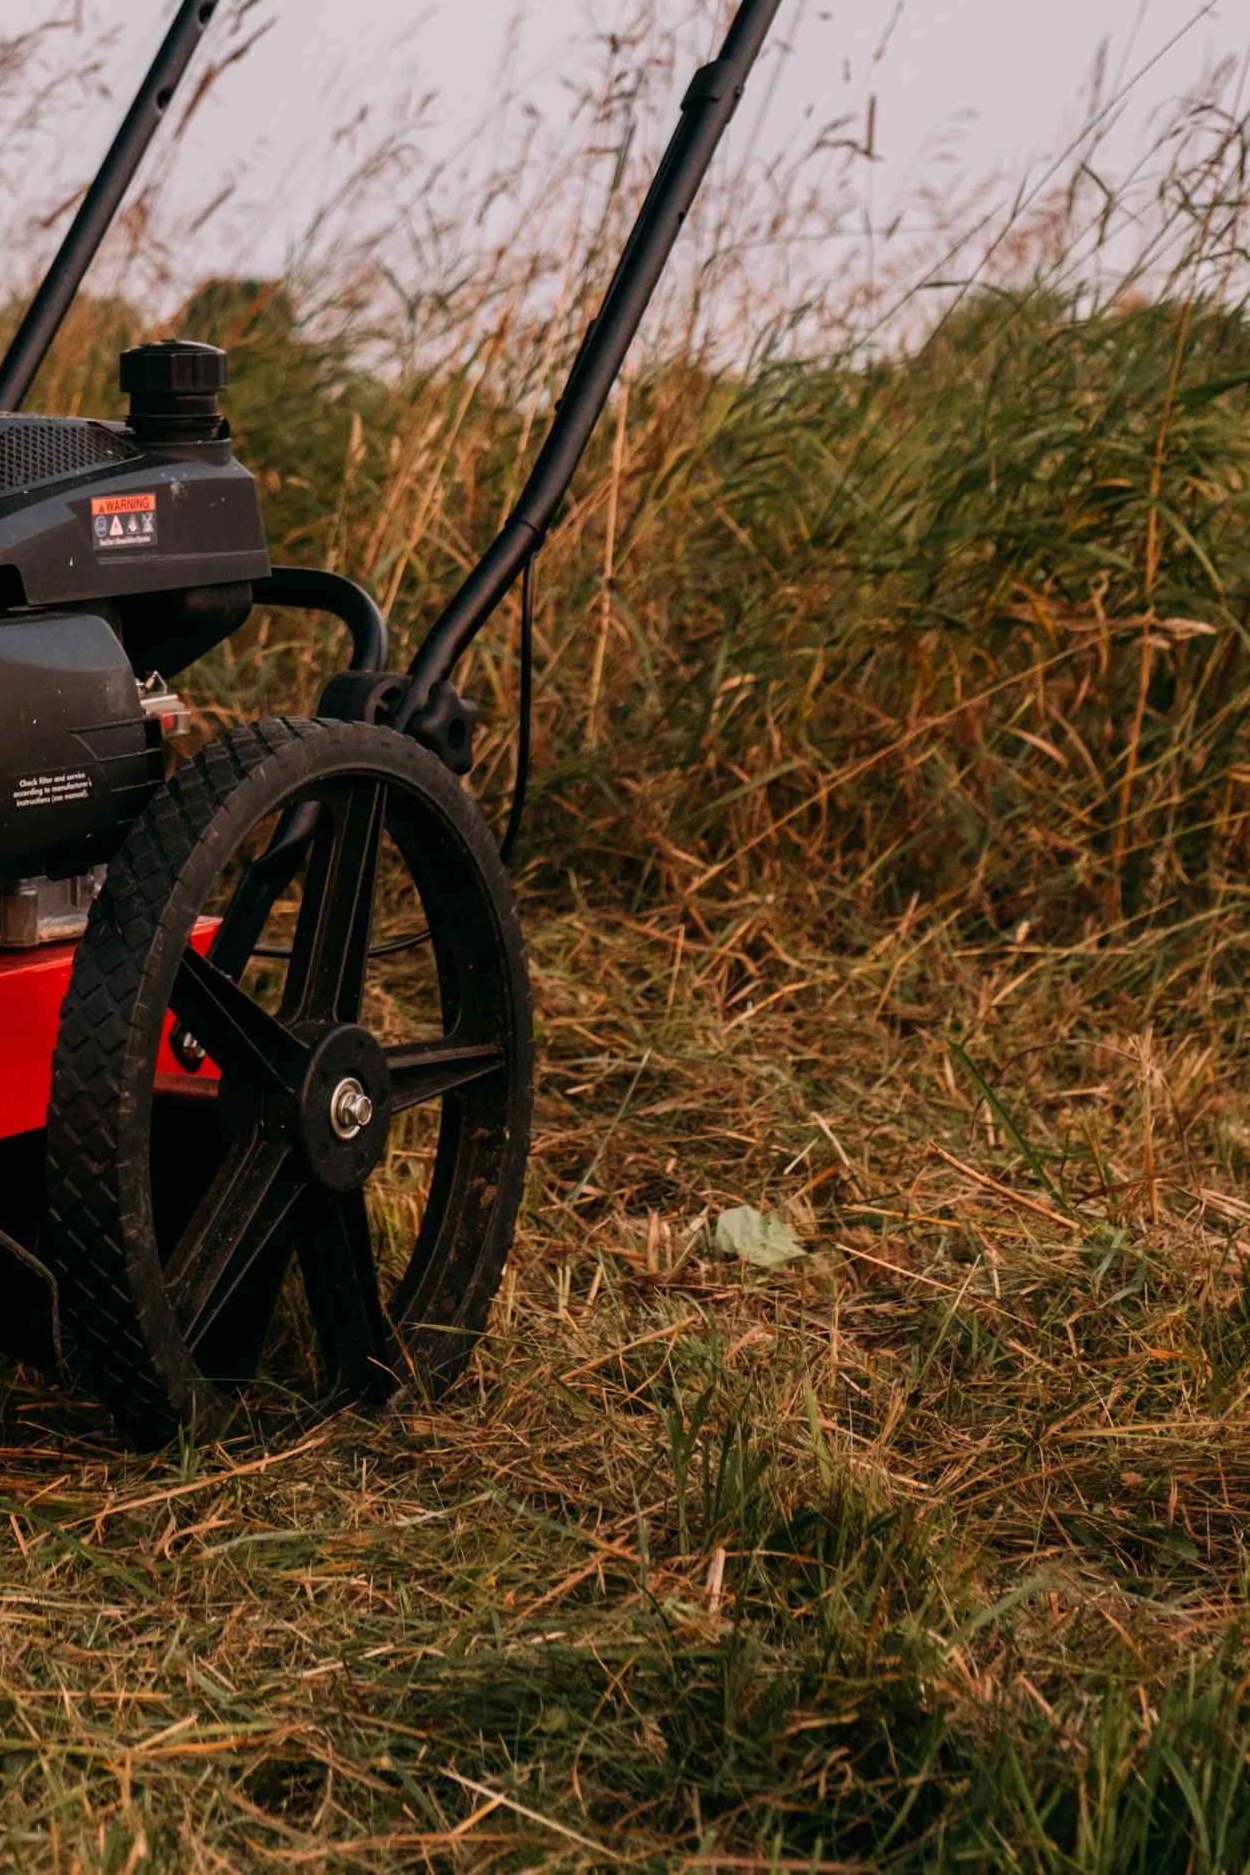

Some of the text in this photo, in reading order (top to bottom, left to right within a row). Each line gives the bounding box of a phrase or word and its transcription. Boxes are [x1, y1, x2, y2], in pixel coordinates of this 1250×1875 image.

[105, 496, 150, 512] WARNING
[19, 771, 86, 788] Check filter and service
[13, 787, 43, 798] according
[16, 796, 51, 807] instructions
[51, 794, 64, 804] (see
